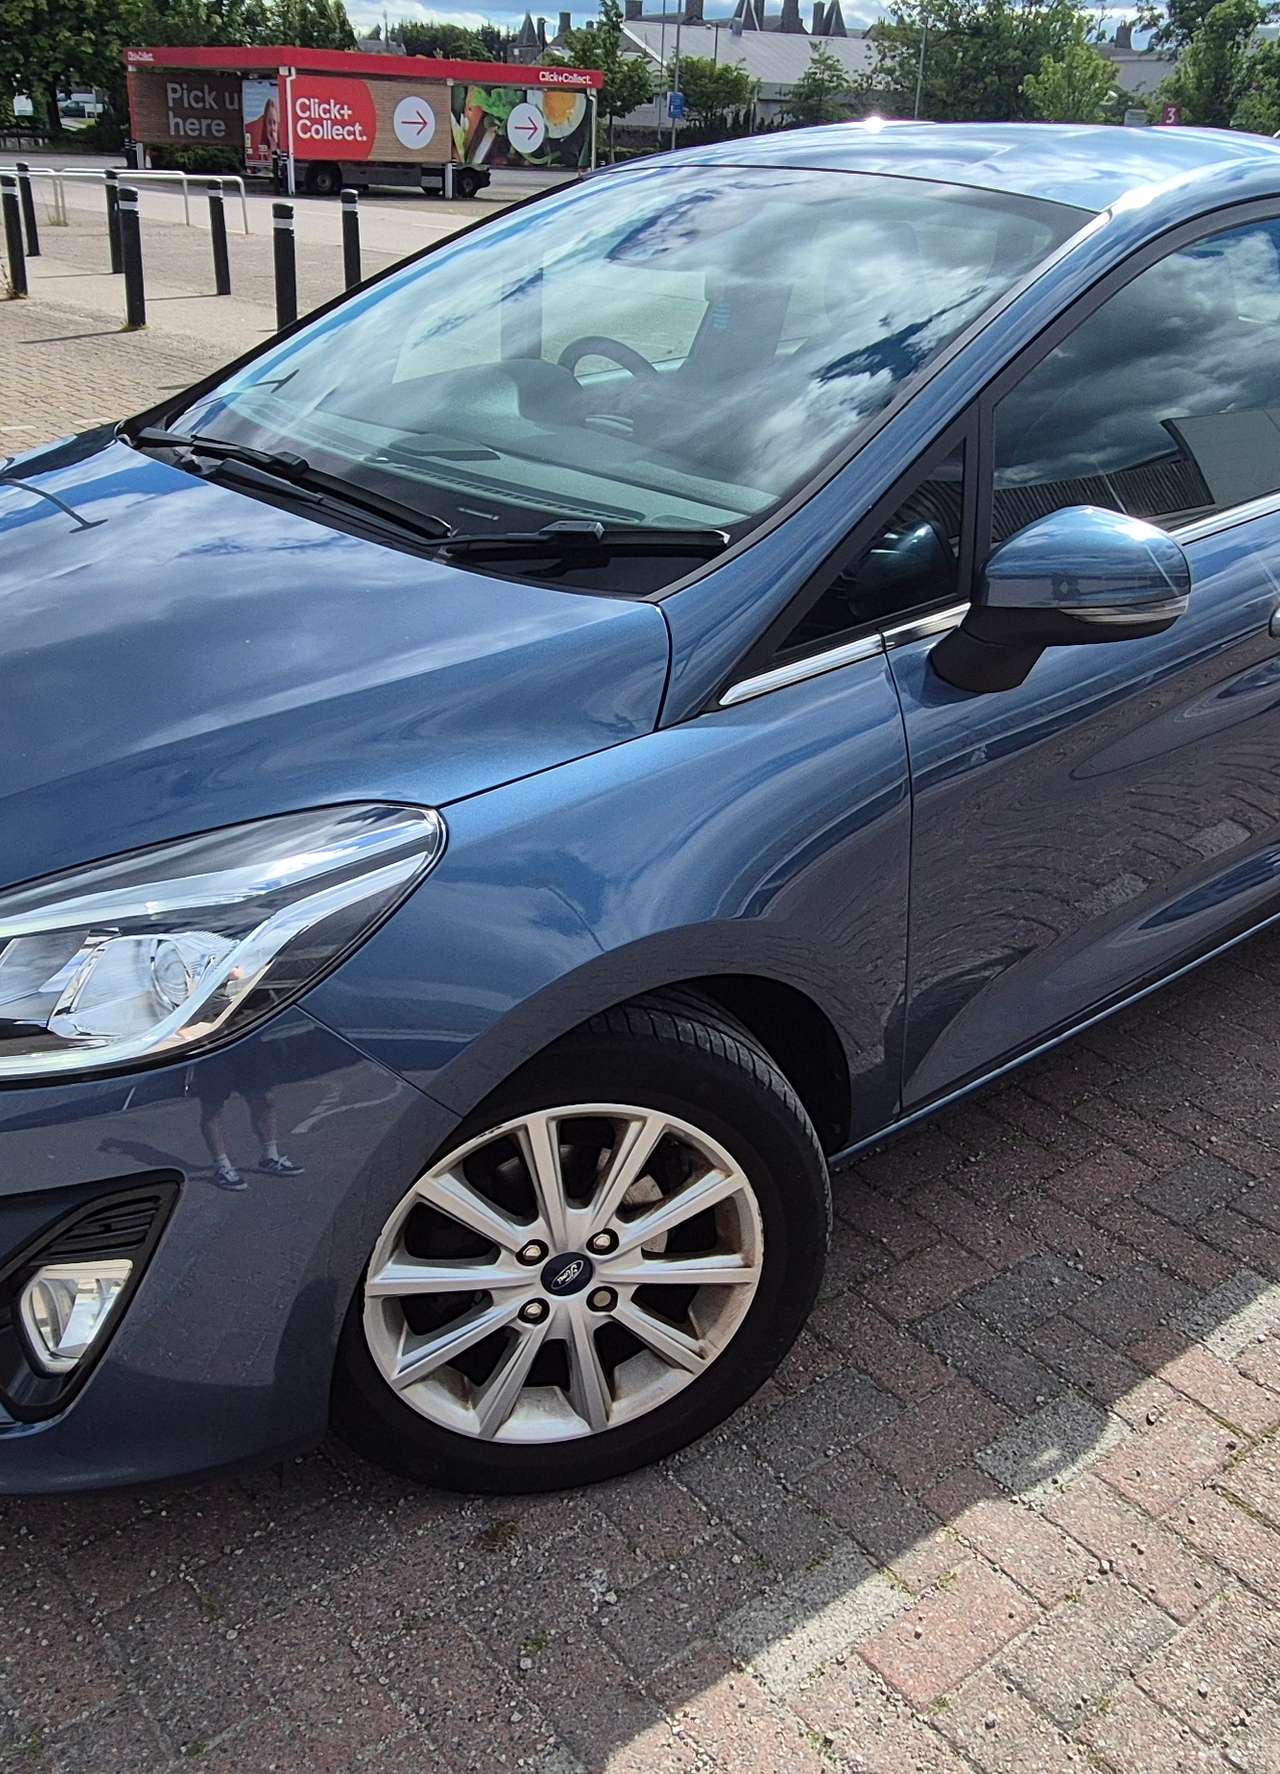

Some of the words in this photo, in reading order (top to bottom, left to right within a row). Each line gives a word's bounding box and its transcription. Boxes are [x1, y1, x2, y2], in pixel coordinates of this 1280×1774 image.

[166, 82, 218, 110] Pick
[224, 92, 240, 110] u
[295, 97, 352, 120] Click+
[1165, 107, 1177, 124] 3
[168, 110, 226, 137] here
[296, 118, 368, 142] Collect.
